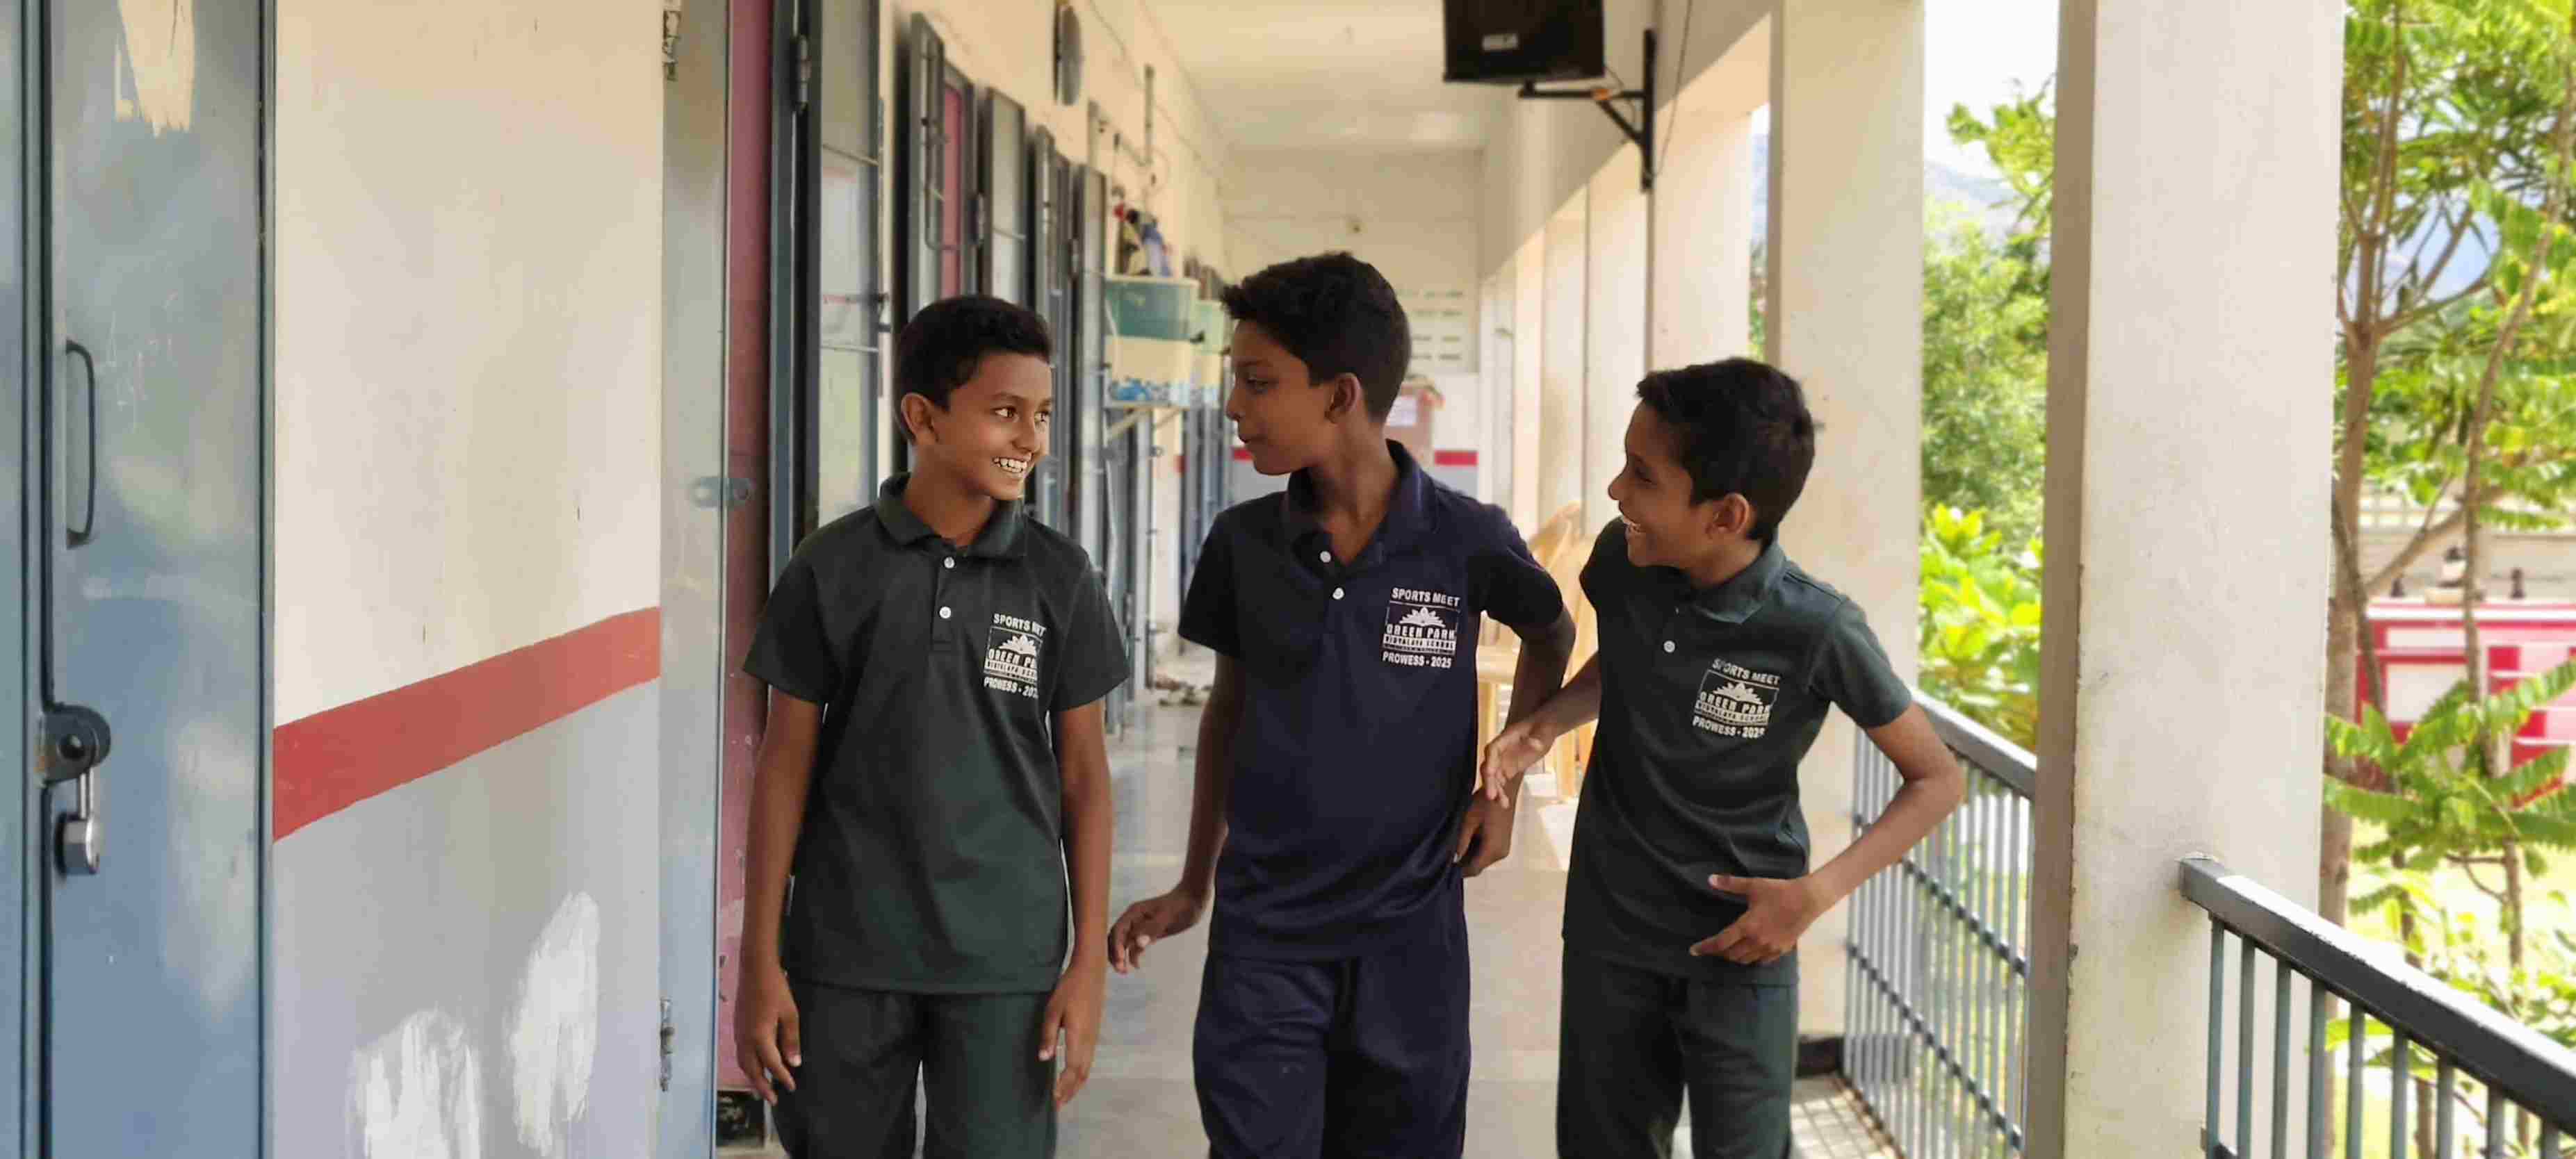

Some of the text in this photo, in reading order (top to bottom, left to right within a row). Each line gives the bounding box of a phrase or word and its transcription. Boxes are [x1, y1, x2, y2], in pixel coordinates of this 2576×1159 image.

[1392, 588, 1460, 607] SPORTS MEET
[993, 613, 1030, 632] SPORTS
[1387, 624, 1455, 640] GREEN PARK
[988, 648, 1020, 664] GREEN
[1383, 651, 1424, 666] PROWESS
[1430, 656, 1452, 668] 2025
[1752, 673, 1781, 685] MEET
[1700, 691, 1737, 711] GREEN
[1693, 716, 1736, 737] PROWESS
